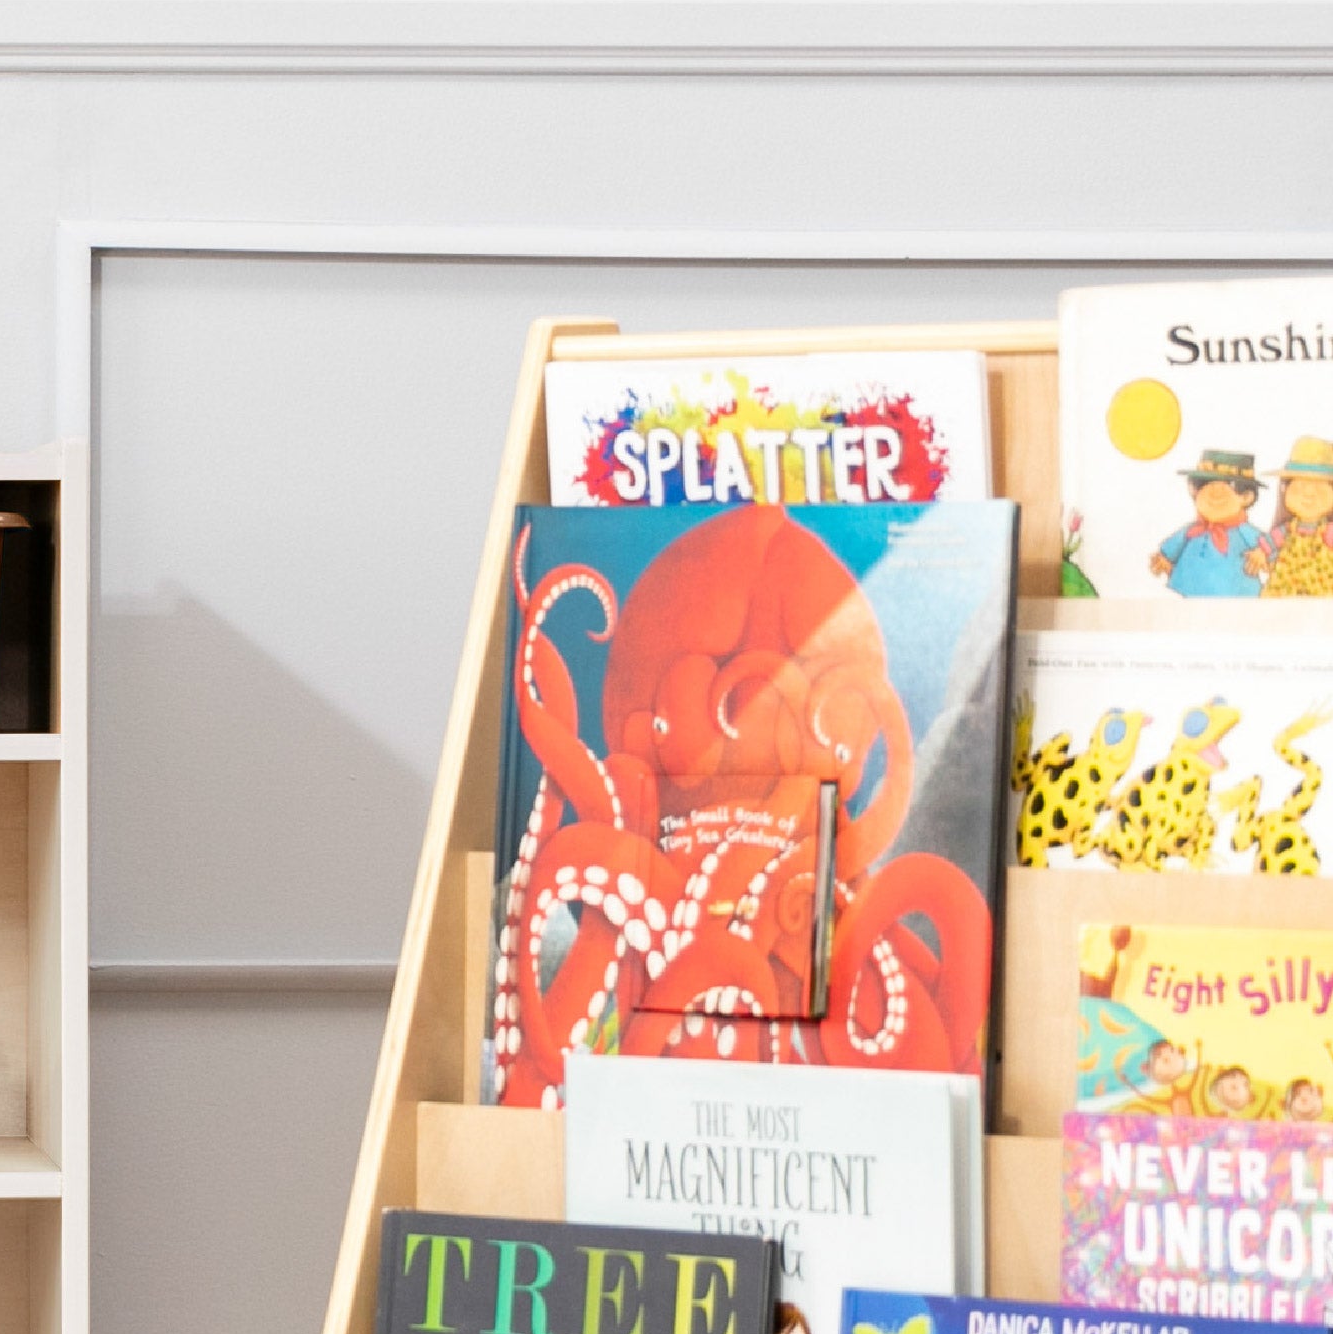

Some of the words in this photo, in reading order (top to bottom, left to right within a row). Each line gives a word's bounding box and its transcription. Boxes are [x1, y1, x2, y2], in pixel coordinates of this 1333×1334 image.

[1166, 321, 1333, 366] Sunshi
[612, 425, 911, 506] SPLATTER
[660, 816, 687, 833] The
[690, 806, 729, 827] Small
[735, 807, 774, 827] Book
[778, 815, 797, 835] of
[660, 835, 693, 854] Tiny
[696, 826, 720, 844] Sea
[1143, 962, 1226, 1014] Eight
[1238, 956, 1333, 1015] Silly
[691, 1100, 735, 1138] THE
[747, 1104, 802, 1143] MOST
[624, 1138, 878, 1217] MAGNIFICENT
[1100, 1140, 1268, 1200] NEVER
